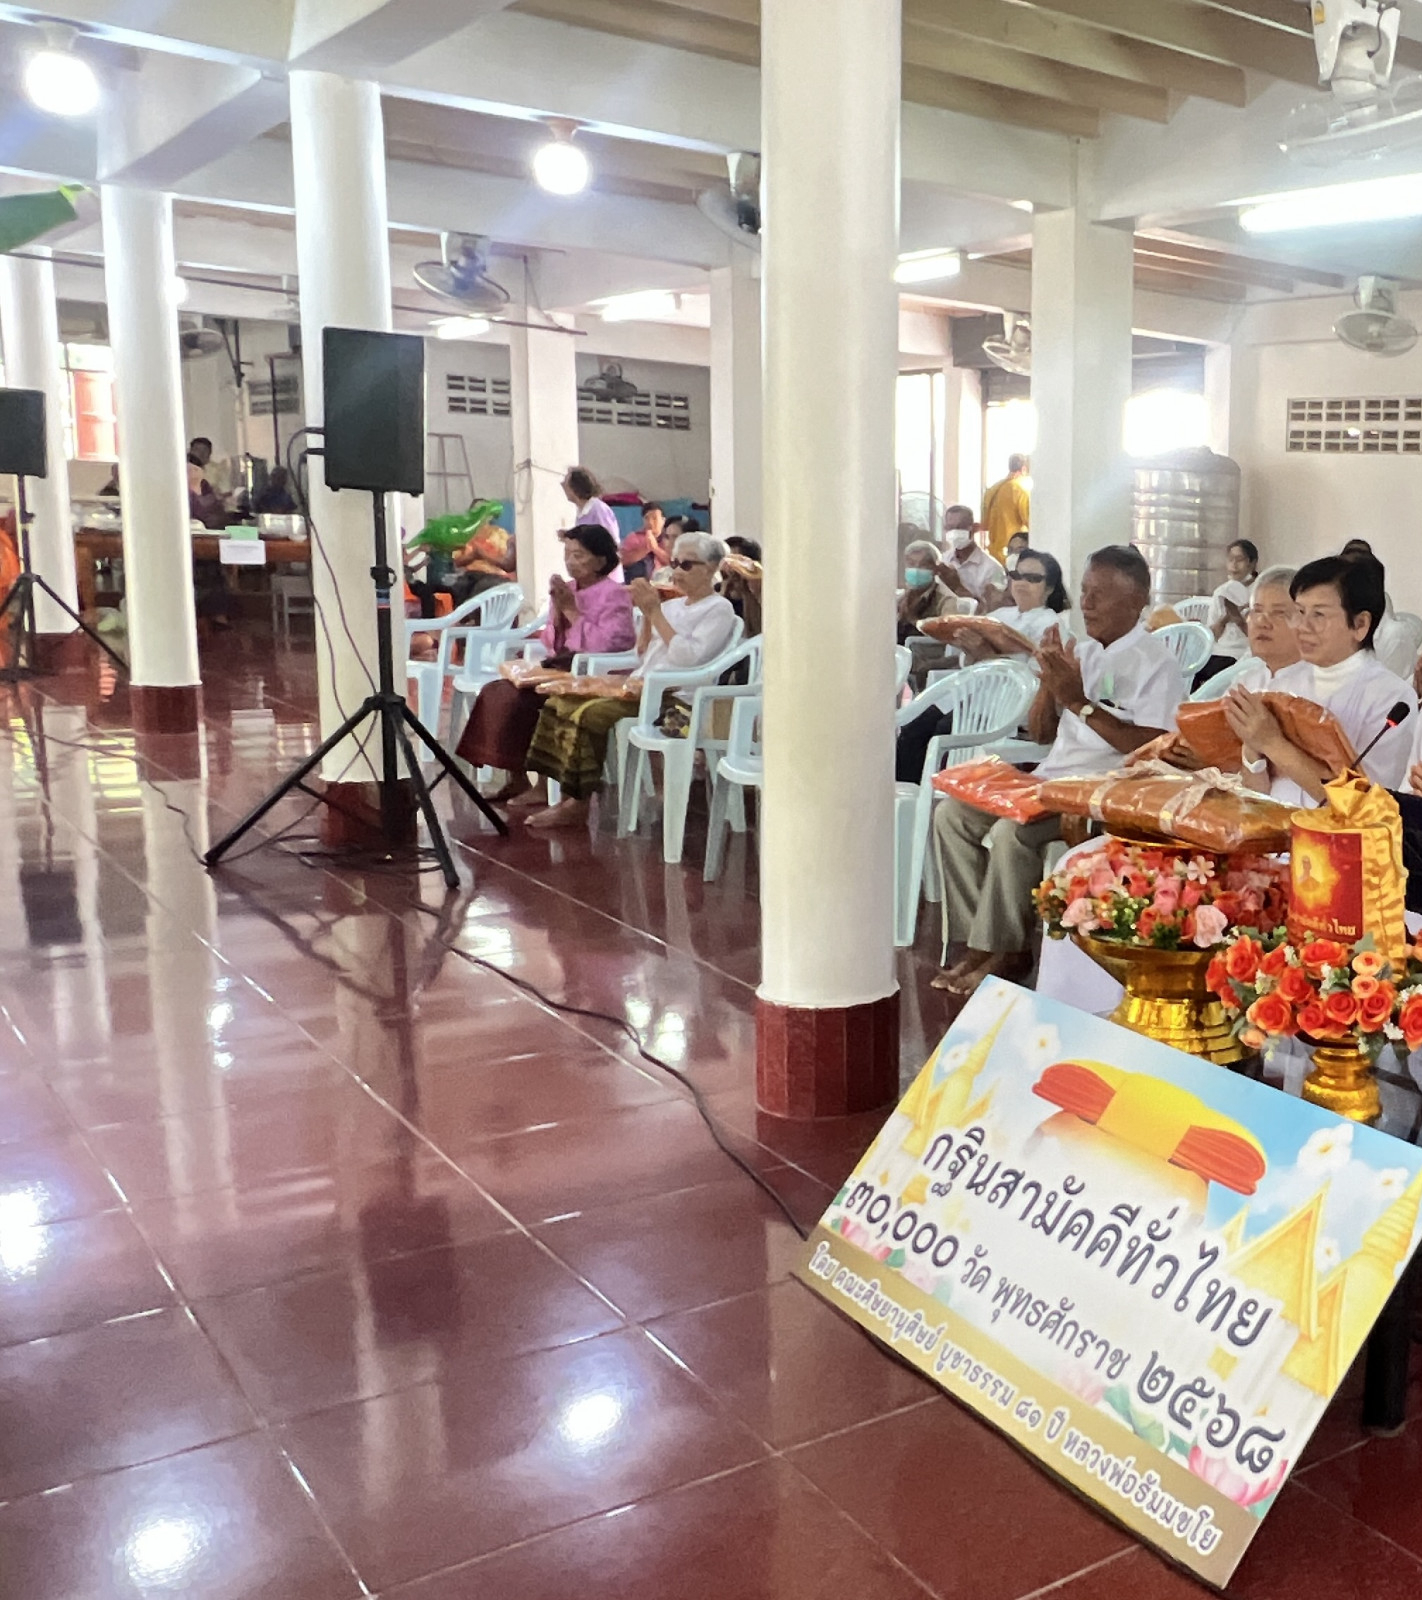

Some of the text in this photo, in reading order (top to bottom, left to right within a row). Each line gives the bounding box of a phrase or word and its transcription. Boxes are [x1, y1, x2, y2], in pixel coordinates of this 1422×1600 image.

[846, 1178, 1285, 1478] ๓๐,๐๐๐ วัด พุทธศักราช ๒๕๖๘
[923, 1126, 1275, 1349] กฐินสามัคคีทั่วไทย
[809, 1242, 1222, 1551] โดย คณะศิษยานุศิษย์ บูชาธรรม ๘๑ ปี หลวงพ่อธัมมชโย
